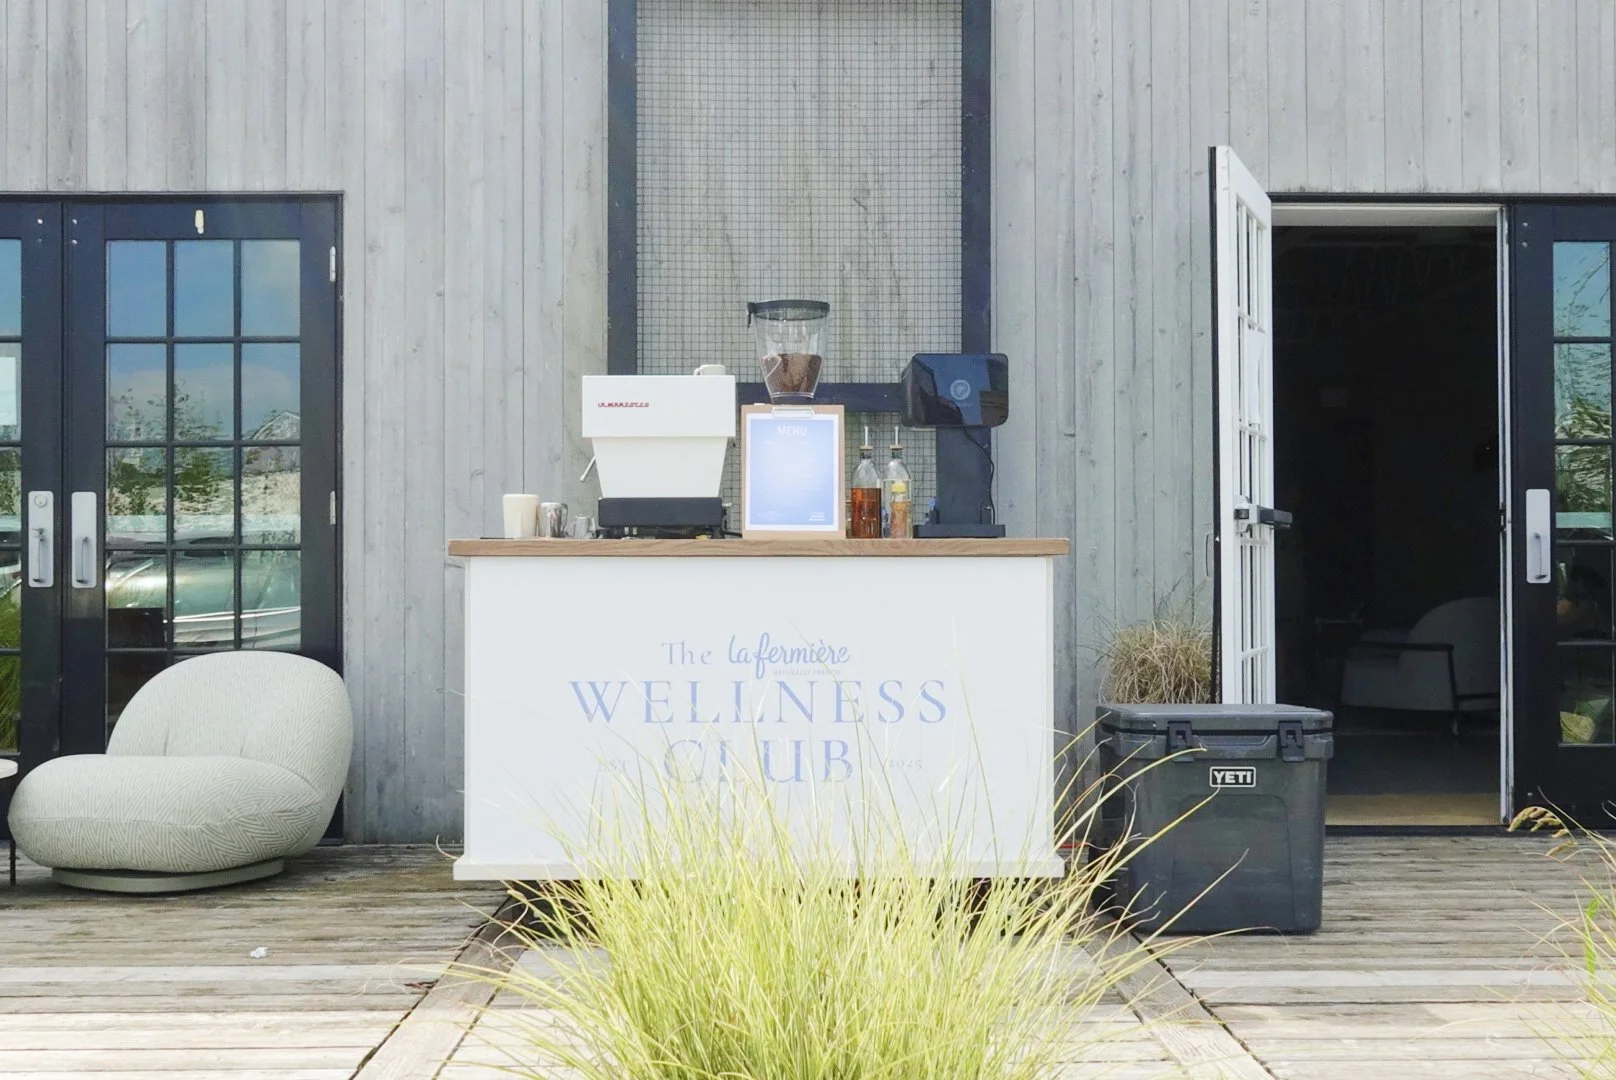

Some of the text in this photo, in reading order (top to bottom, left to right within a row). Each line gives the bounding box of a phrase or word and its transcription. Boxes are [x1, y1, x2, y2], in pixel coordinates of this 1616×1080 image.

[776, 425, 808, 437] MENU
[660, 640, 713, 665] The
[568, 679, 947, 724] WELLNESS
[663, 738, 853, 783] CLUB
[888, 758, 923, 772] 2025
[1212, 770, 1253, 784] YETI
